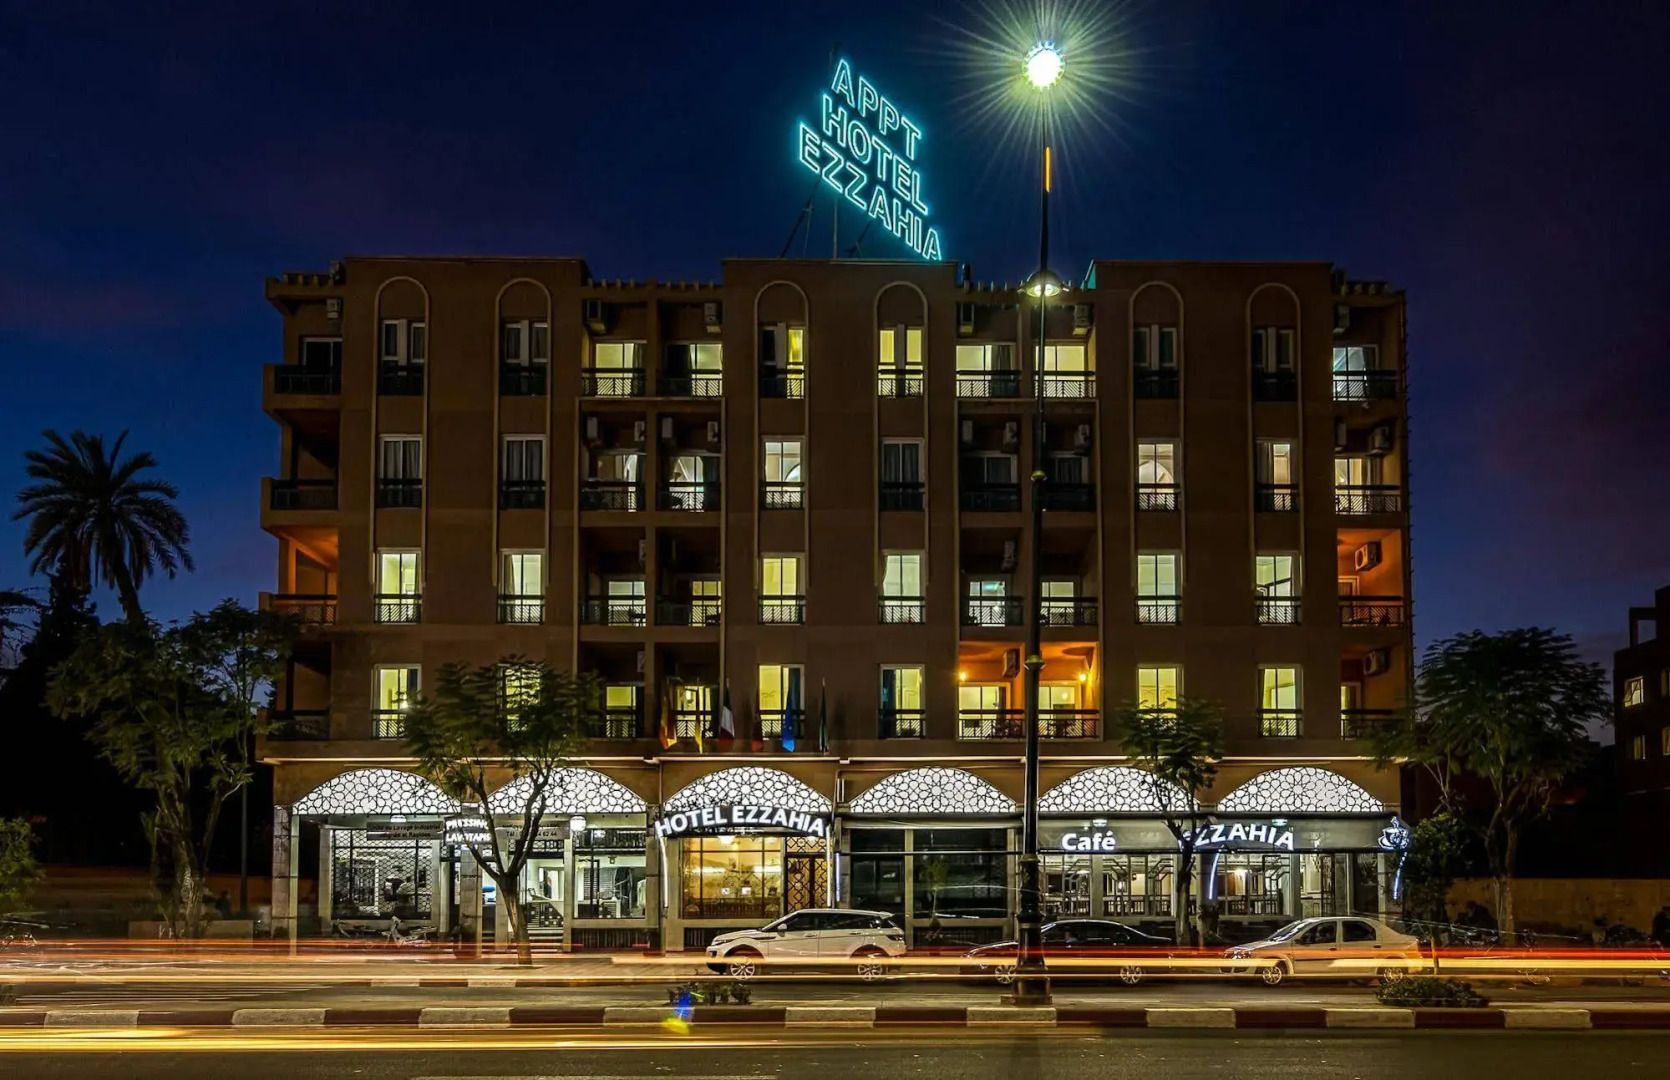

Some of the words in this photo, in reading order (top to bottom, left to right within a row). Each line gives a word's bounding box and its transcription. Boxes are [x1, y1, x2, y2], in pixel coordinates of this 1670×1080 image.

[822, 93, 928, 215] HOTEL
[831, 58, 921, 160] APPT
[799, 121, 942, 260] EZZAHIA
[655, 806, 727, 836] HOTEL
[732, 805, 824, 836] EZZAHIA
[1062, 831, 1115, 850] Café
